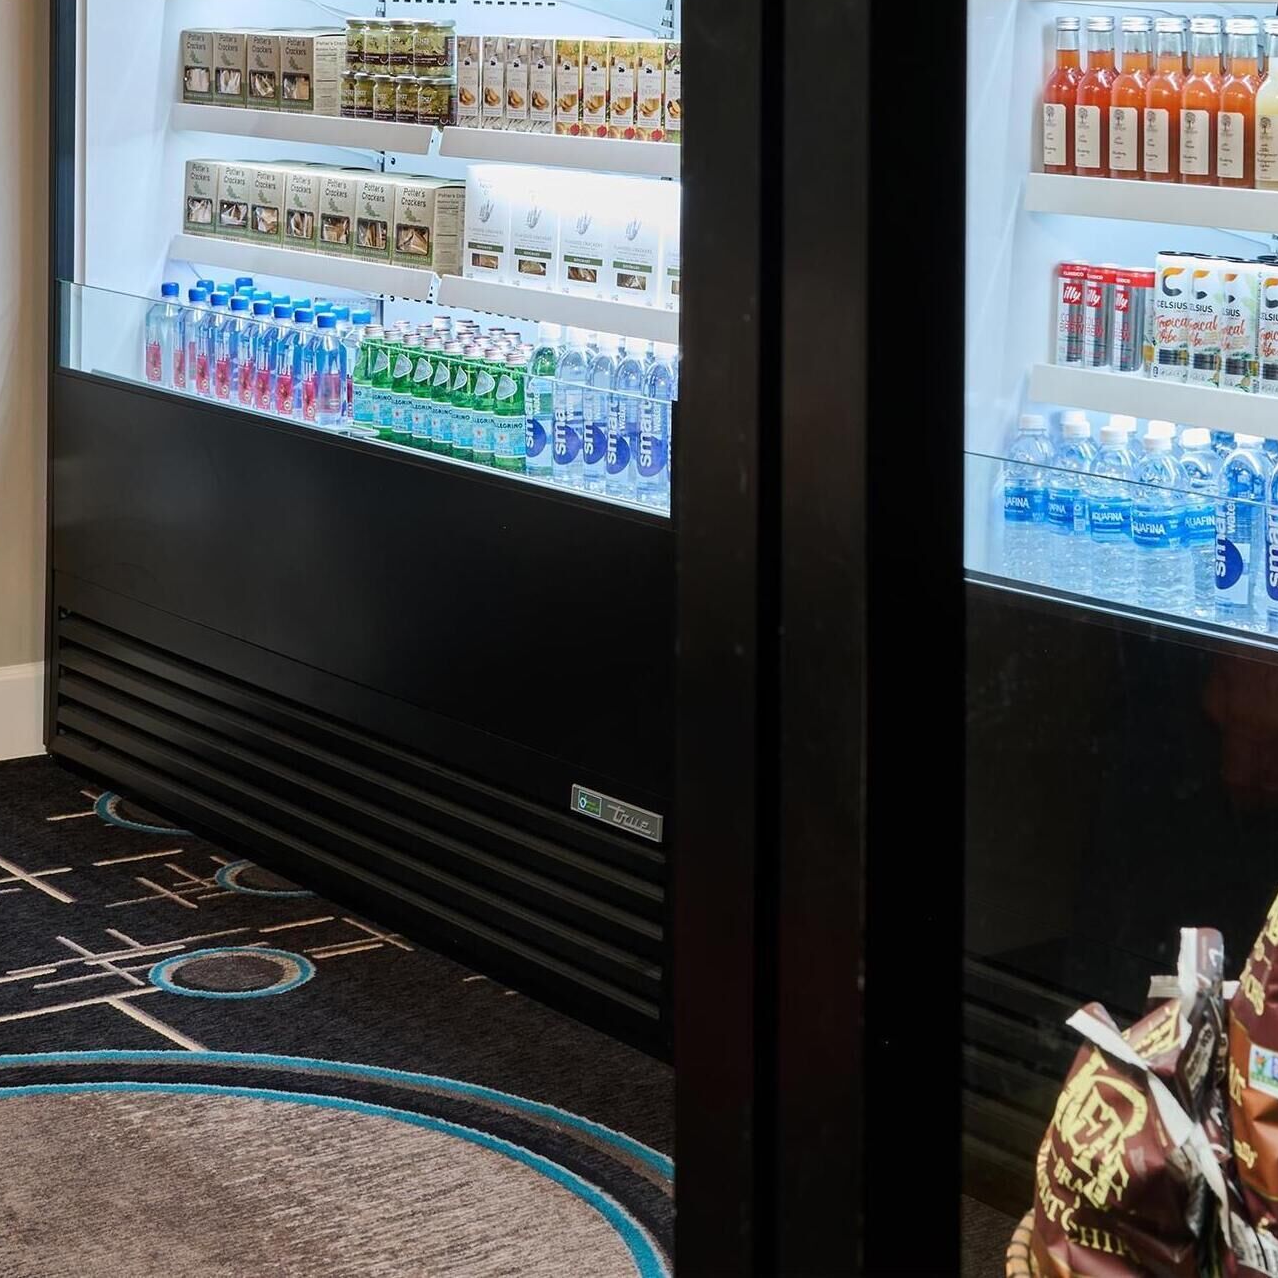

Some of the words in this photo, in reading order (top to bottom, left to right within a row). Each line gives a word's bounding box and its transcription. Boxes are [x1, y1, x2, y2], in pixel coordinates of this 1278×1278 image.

[404, 188, 425, 197] Potter's
[362, 193, 384, 202] Crackers
[402, 198, 426, 207] Crackers
[1064, 286, 1081, 303] illy
